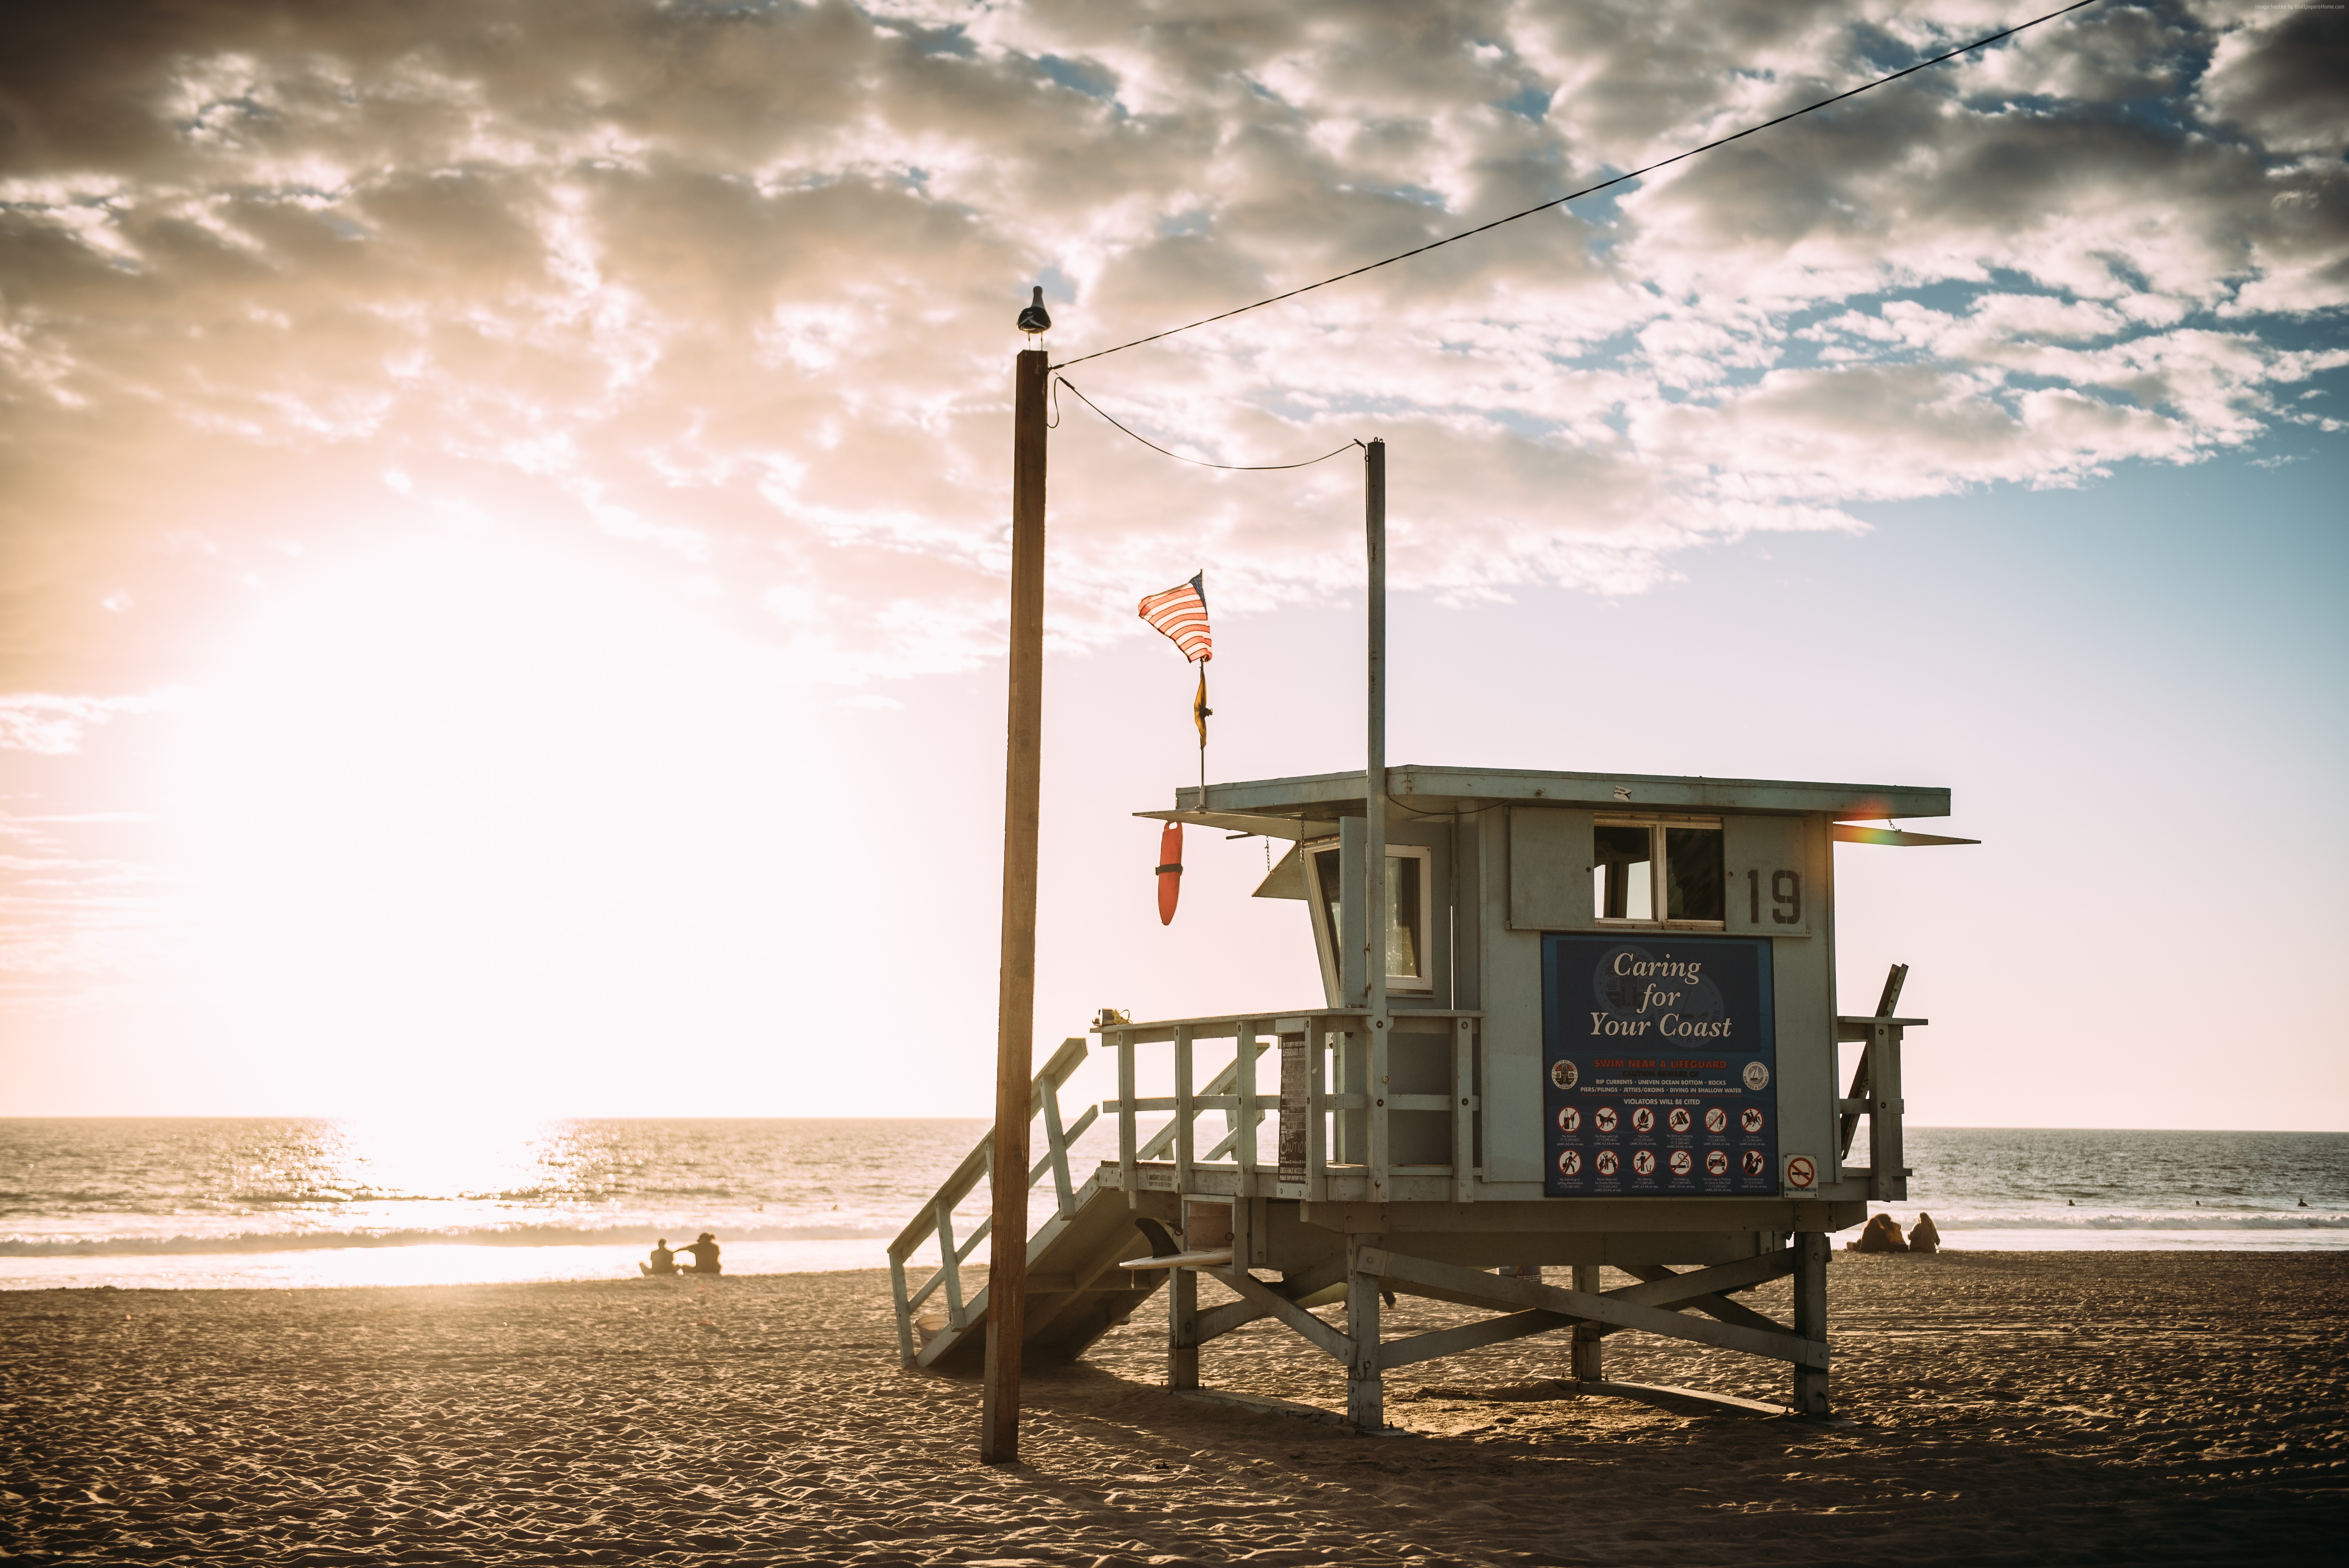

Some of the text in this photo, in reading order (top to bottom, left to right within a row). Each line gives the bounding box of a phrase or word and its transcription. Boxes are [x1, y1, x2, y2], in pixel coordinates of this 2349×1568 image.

[1747, 870, 1801, 925] 19
[1614, 953, 1701, 985] Caring
[1636, 983, 1681, 1014] for
[1590, 1012, 1651, 1036] Your
[1659, 1013, 1732, 1037] Coast
[1283, 1048, 1298, 1056] LIFEGUARD
[1594, 1059, 1727, 1069] SWIM NEAR A LIFEGUARD
